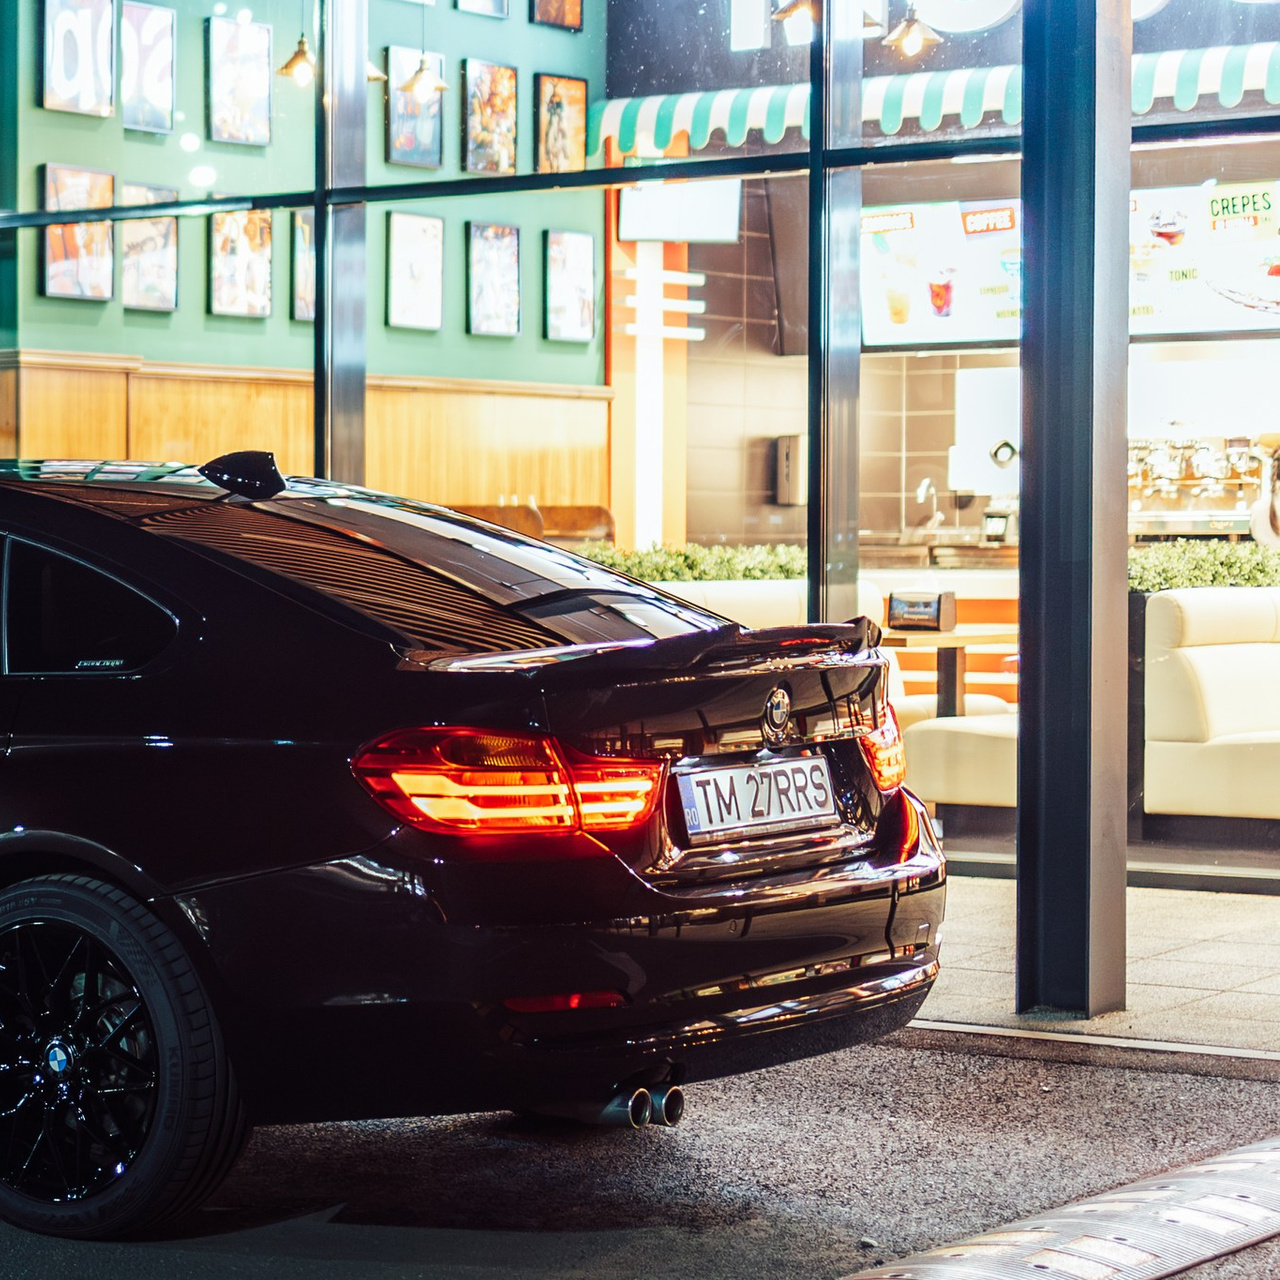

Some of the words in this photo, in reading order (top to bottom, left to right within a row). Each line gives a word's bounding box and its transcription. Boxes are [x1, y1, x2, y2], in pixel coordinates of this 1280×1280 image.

[1210, 192, 1272, 218] CREPES
[964, 210, 1012, 233] COFFEE
[1169, 267, 1199, 282] TONIC
[695, 774, 742, 825] TM
[686, 808, 699, 827] RO
